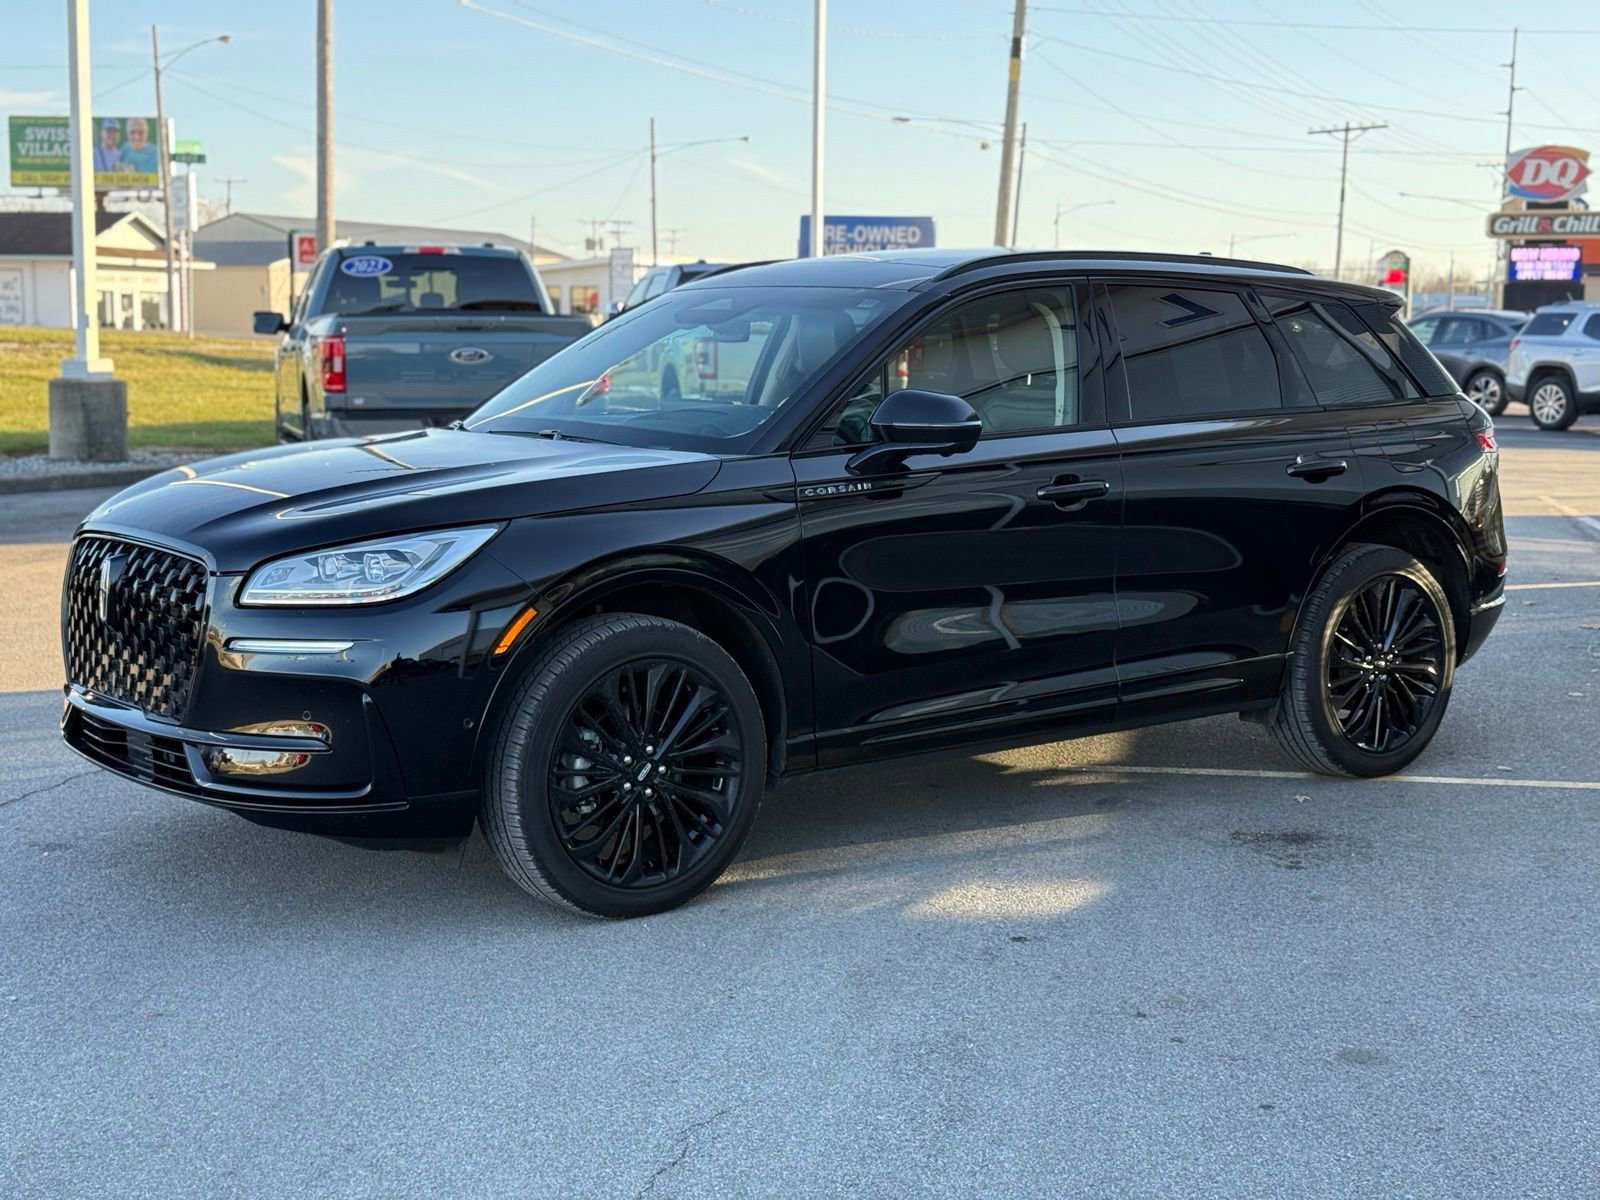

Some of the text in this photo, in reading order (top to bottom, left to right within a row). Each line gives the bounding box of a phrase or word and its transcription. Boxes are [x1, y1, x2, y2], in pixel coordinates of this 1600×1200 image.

[17, 142, 72, 157] VILLAG
[1520, 159, 1579, 189] DQ
[1495, 216, 1538, 233] Grill
[1553, 215, 1600, 232] Chill
[824, 224, 921, 243] RE-OWNED
[824, 244, 908, 255] VEHIC
[350, 259, 384, 272] 2023
[805, 482, 872, 497] CORSAIR
